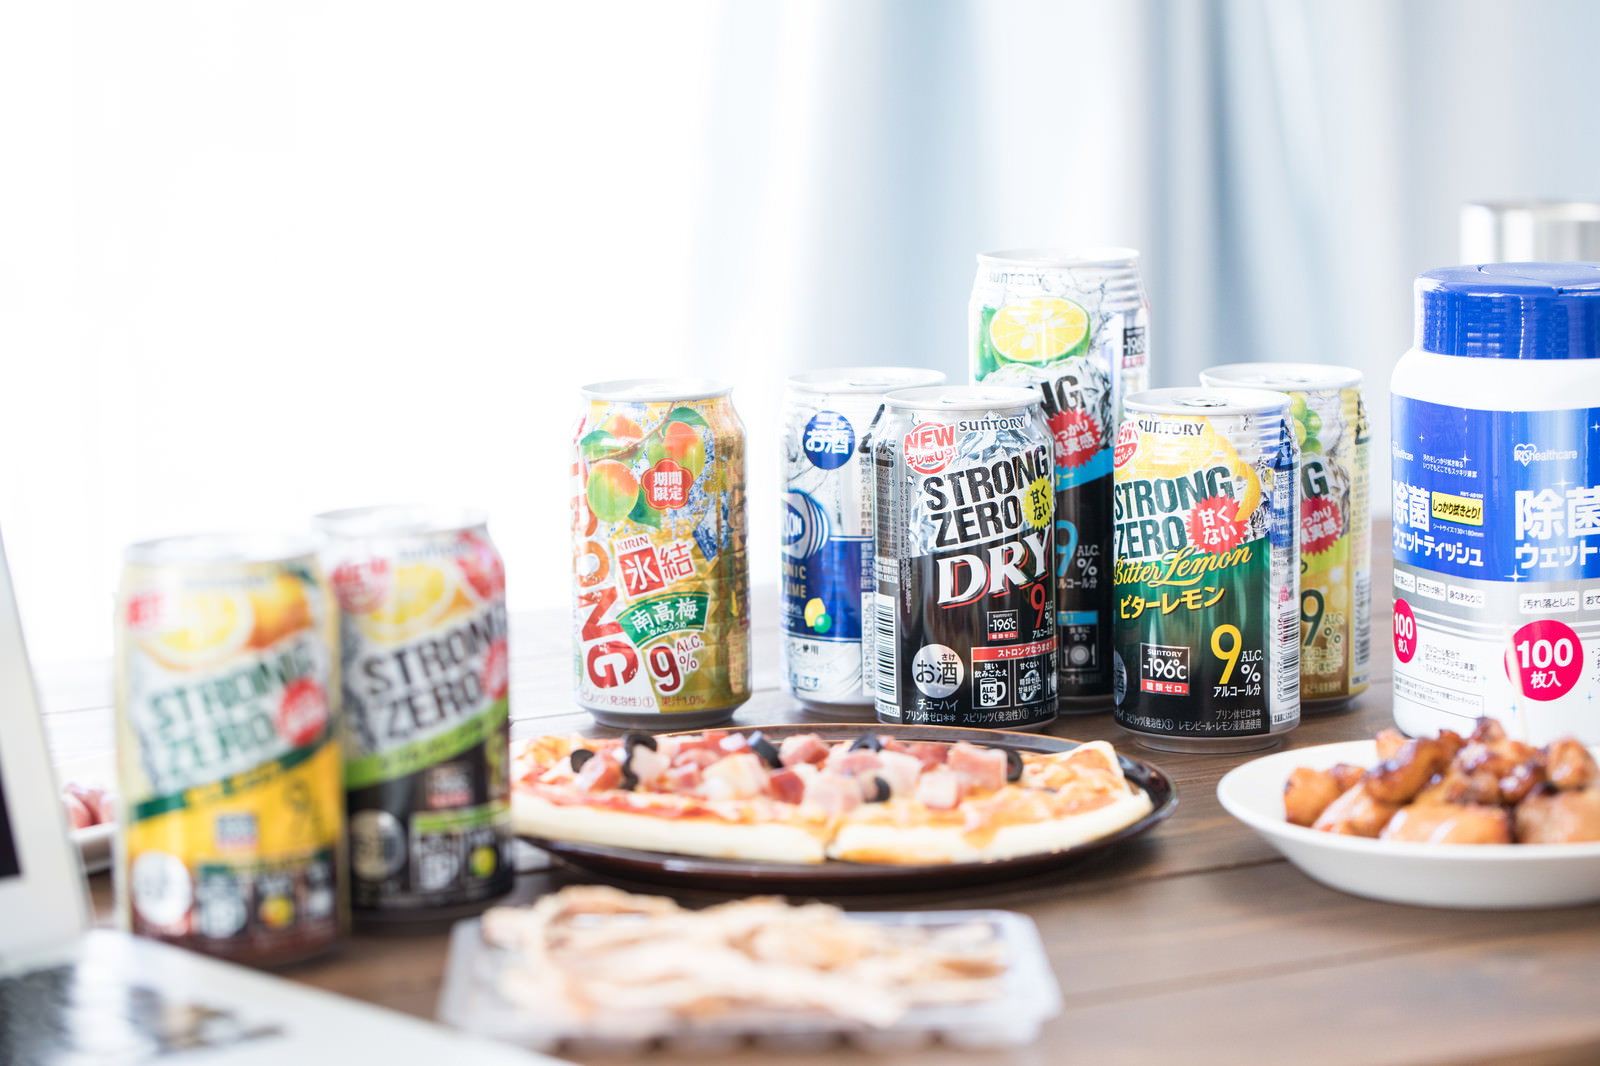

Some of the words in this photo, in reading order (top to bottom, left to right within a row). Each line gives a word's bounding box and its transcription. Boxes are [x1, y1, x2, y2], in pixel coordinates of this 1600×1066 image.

[805, 428, 850, 454] お酒
[904, 425, 955, 456] NEW
[653, 472, 683, 487] 期間
[923, 445, 1049, 511] STRONG
[653, 486, 683, 501] 限定
[1031, 485, 1047, 504] 甘く
[1114, 466, 1235, 521] STRONG
[1393, 480, 1430, 532] 除菌
[930, 495, 1023, 548] ZERO
[1033, 502, 1051, 521] ない
[1199, 505, 1231, 527] 甘く
[1433, 499, 1481, 520] しっかり拭きとり!
[1515, 486, 1600, 541] 除菌
[616, 536, 649, 551] KIRIN
[1056, 520, 1079, 577] 9
[1114, 515, 1188, 560] ZERO
[1203, 525, 1237, 545] ない
[1393, 526, 1484, 567] ウェットティッシュ
[622, 543, 694, 592] 氷結
[936, 530, 1052, 608] DRY
[1114, 555, 1162, 586] Bitter
[1148, 545, 1253, 588] Lemon
[630, 597, 699, 634] 南高梅
[1031, 583, 1046, 628] 9
[1120, 587, 1226, 620] ビターレモン
[1523, 597, 1576, 609] 汚れ落としに
[1300, 589, 1325, 646] 9
[1394, 613, 1413, 640] 100
[941, 653, 956, 662] さけ
[984, 663, 999, 671] 強い
[1019, 661, 1040, 671] 甘くない
[1210, 624, 1243, 685] 9
[1241, 650, 1264, 663] ALC.
[1517, 638, 1574, 669] 100
[650, 645, 681, 692] 9
[679, 653, 698, 672] %
[915, 659, 958, 686] お酒
[974, 669, 1008, 679] 飲みごたえ
[1241, 664, 1261, 684] %
[1530, 670, 1562, 689] 枚入
[917, 698, 959, 711] チューハイ
[1213, 684, 1262, 698] アルコール分
